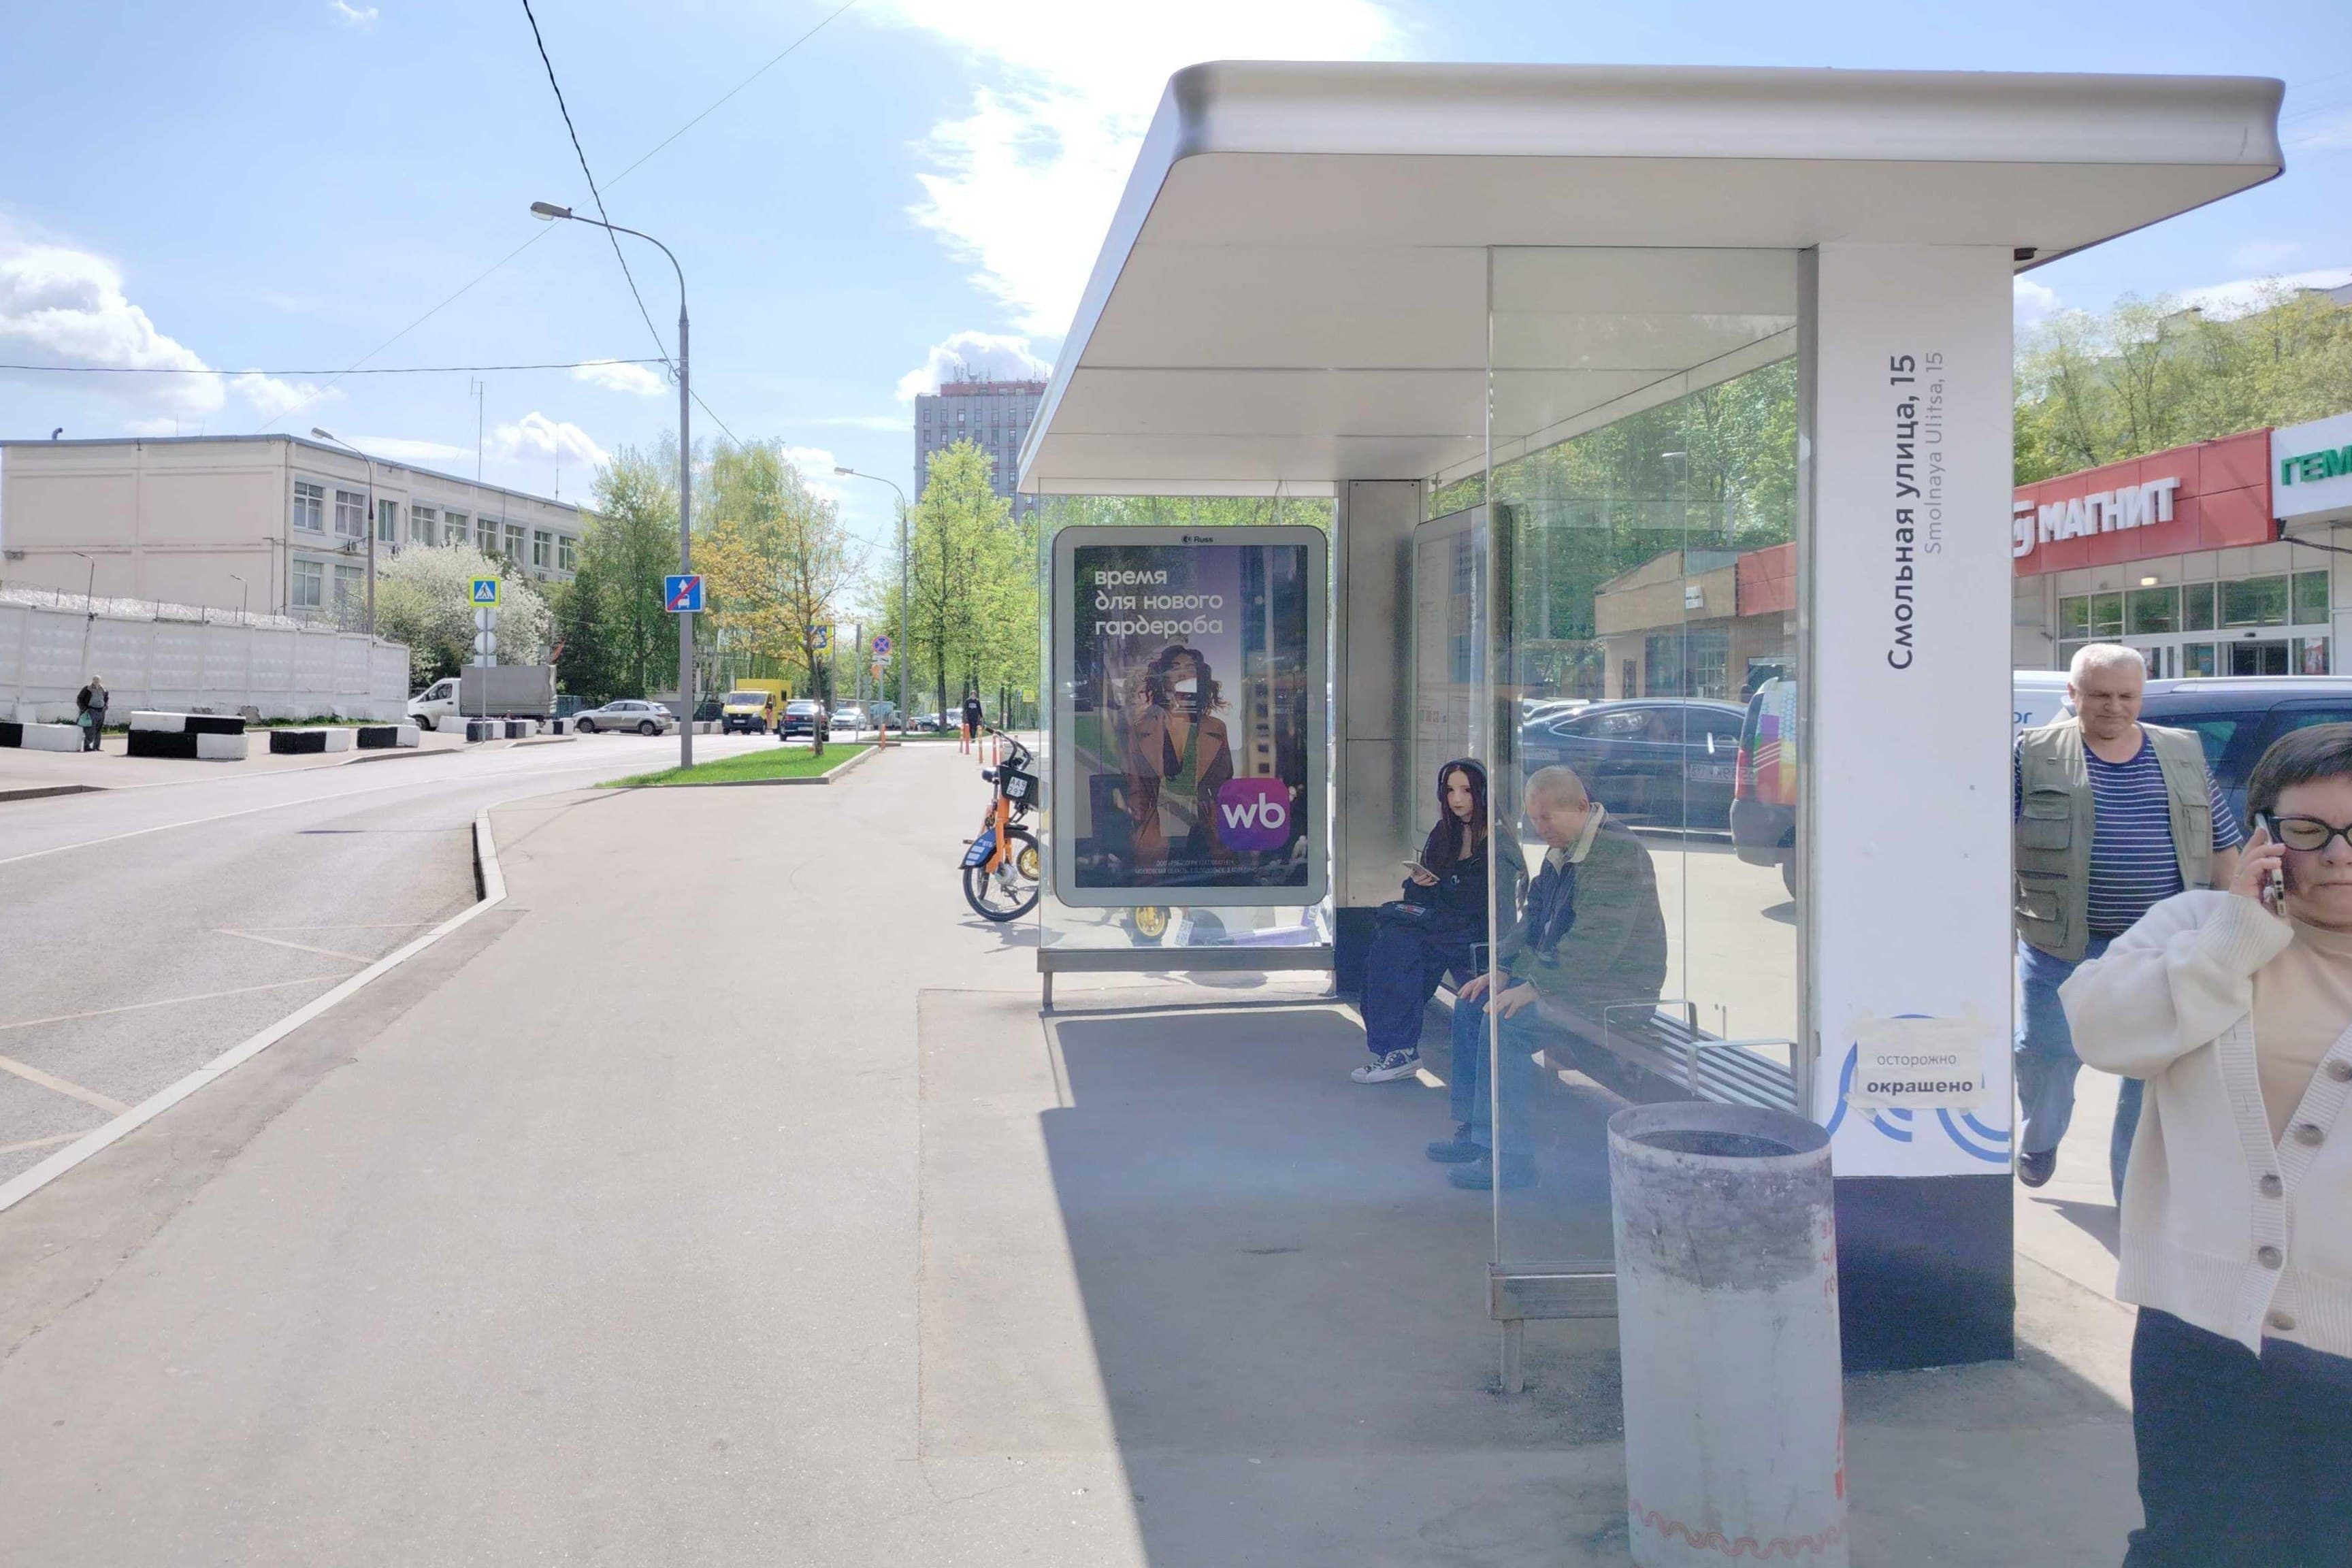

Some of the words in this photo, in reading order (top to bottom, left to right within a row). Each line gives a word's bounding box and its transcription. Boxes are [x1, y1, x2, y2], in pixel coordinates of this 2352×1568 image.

[1890, 355, 1916, 387] 15
[1925, 352, 1944, 373] 15
[1925, 378, 1946, 444] Ulitsa,
[1895, 395, 1921, 499] улица,
[1923, 452, 1946, 555] Smolnaya
[2038, 476, 2180, 544] МАГНИТ
[1193, 535, 1214, 543] Russ
[1095, 570, 1167, 589] время
[1887, 508, 1914, 670] Смольная
[1095, 590, 1136, 610] для
[1143, 595, 1224, 610] нового
[1096, 615, 1223, 640] гардероба
[1221, 792, 1286, 829] wb
[1877, 1054, 1957, 1067] осторожно
[1867, 1081, 1973, 1096] окрашено
